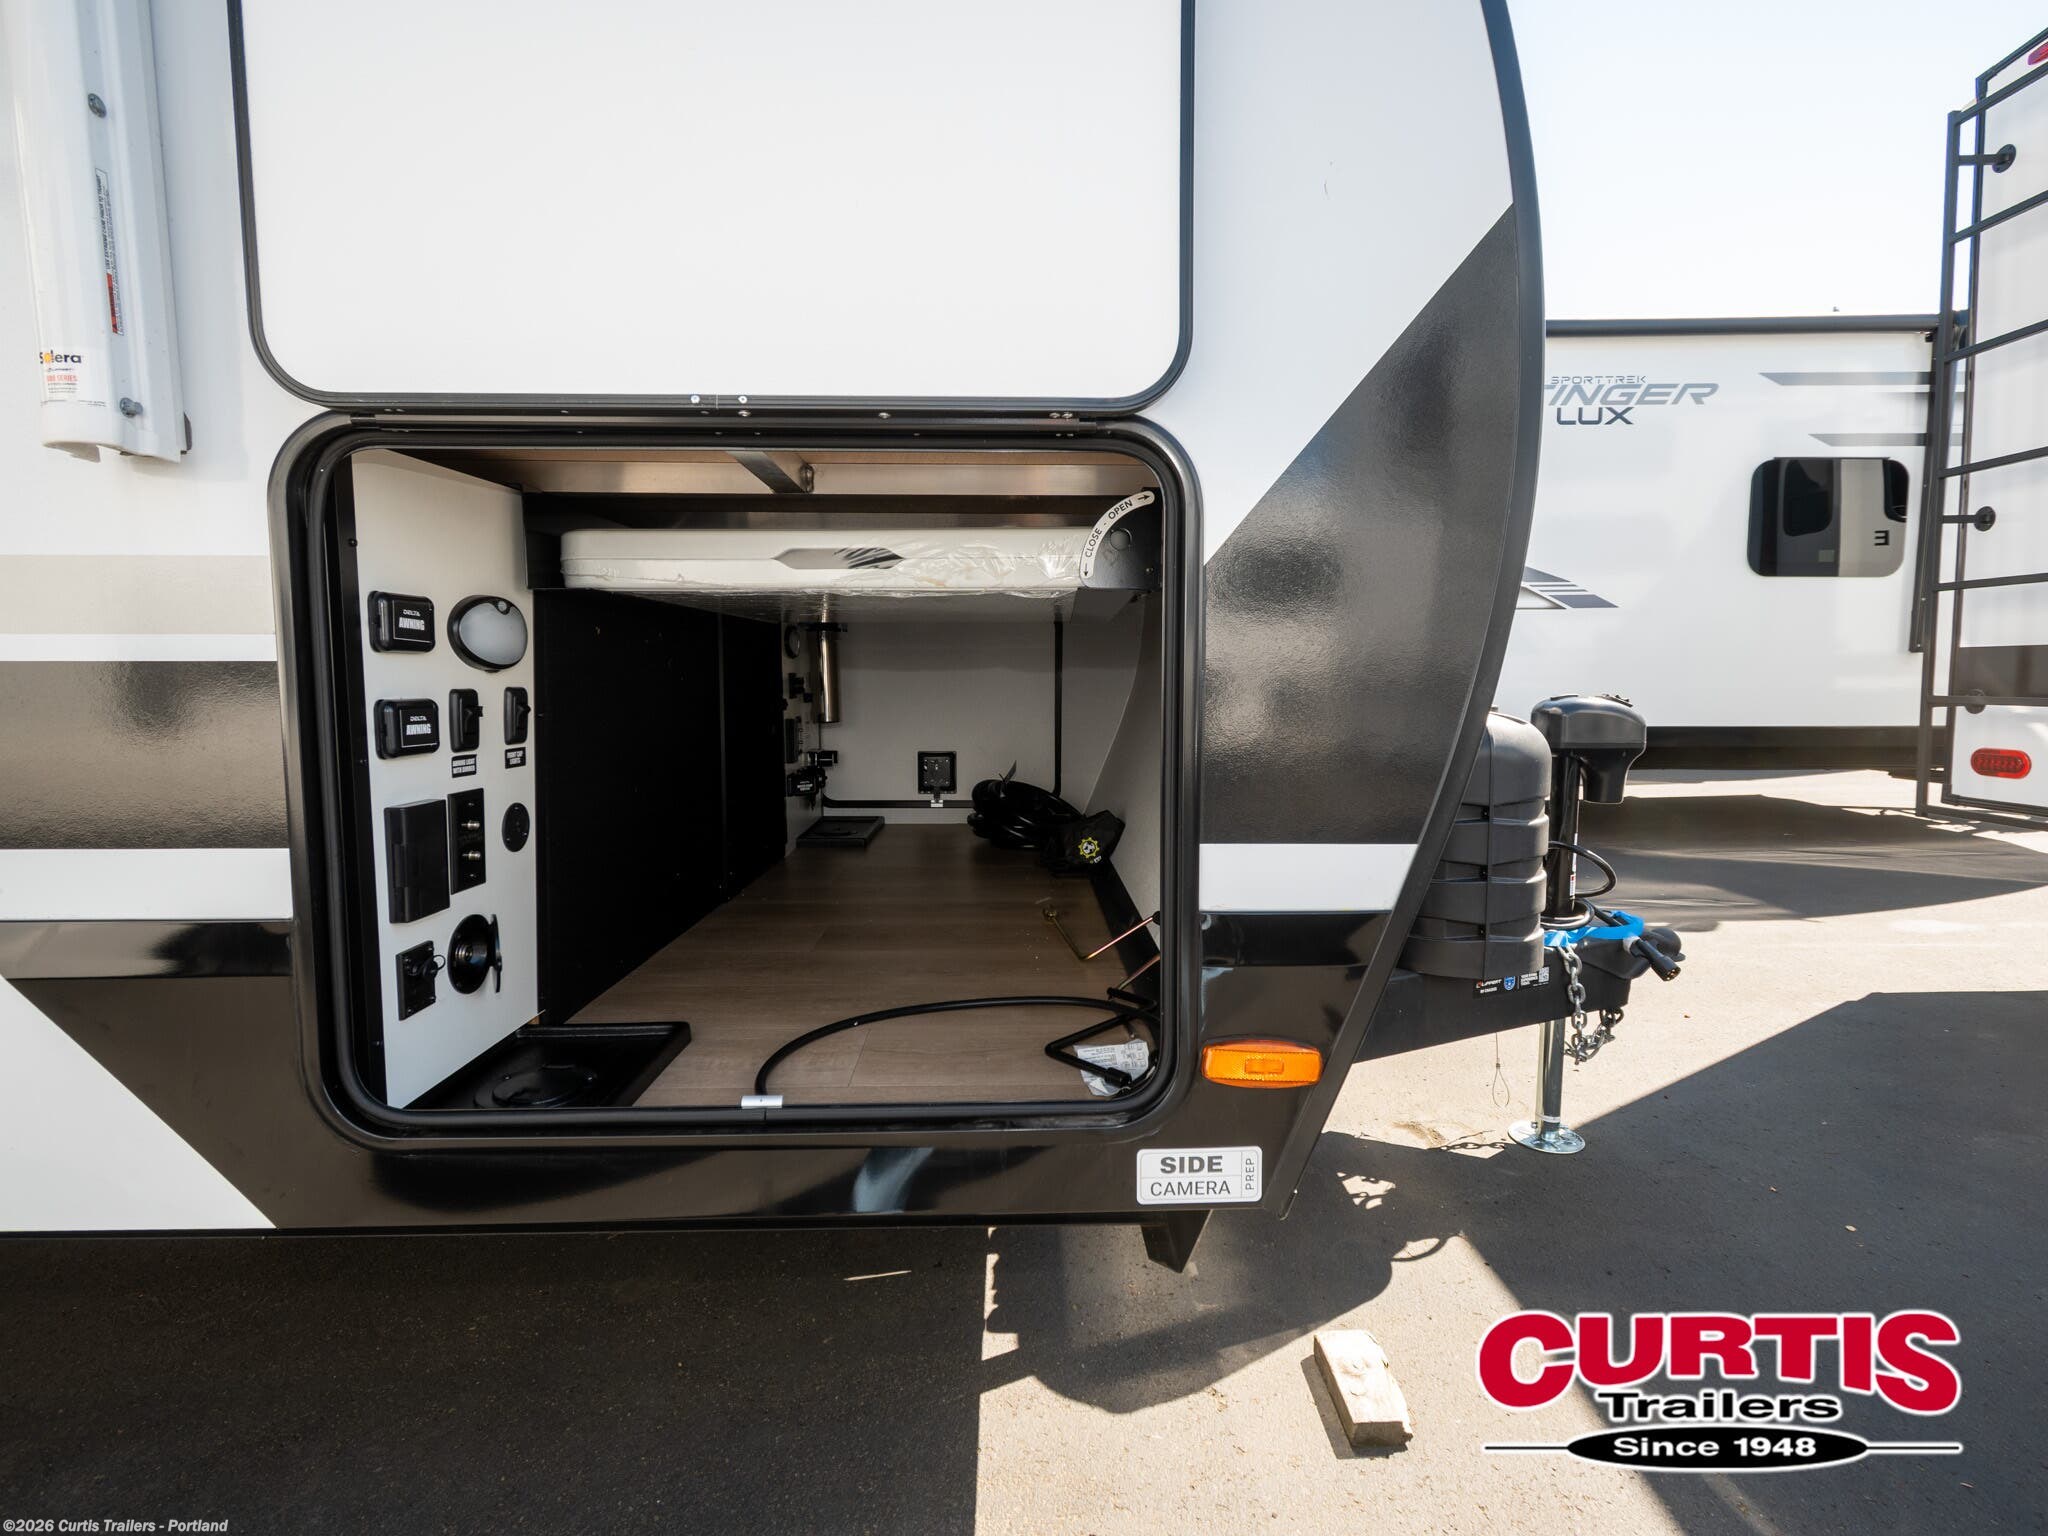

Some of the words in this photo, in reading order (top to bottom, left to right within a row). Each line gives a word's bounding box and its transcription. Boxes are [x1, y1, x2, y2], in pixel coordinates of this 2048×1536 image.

[1551, 375, 1647, 385] SPORTTREK
[1556, 406, 1635, 425] LUX
[1085, 528, 1103, 558] CLOSE
[1108, 500, 1133, 519] OPEN
[399, 616, 425, 630] AWNING
[406, 723, 432, 735] AWNING
[1160, 1155, 1223, 1174] SIDE
[1245, 1157, 1255, 1190] PREP
[1150, 1180, 1231, 1197] CAMERA
